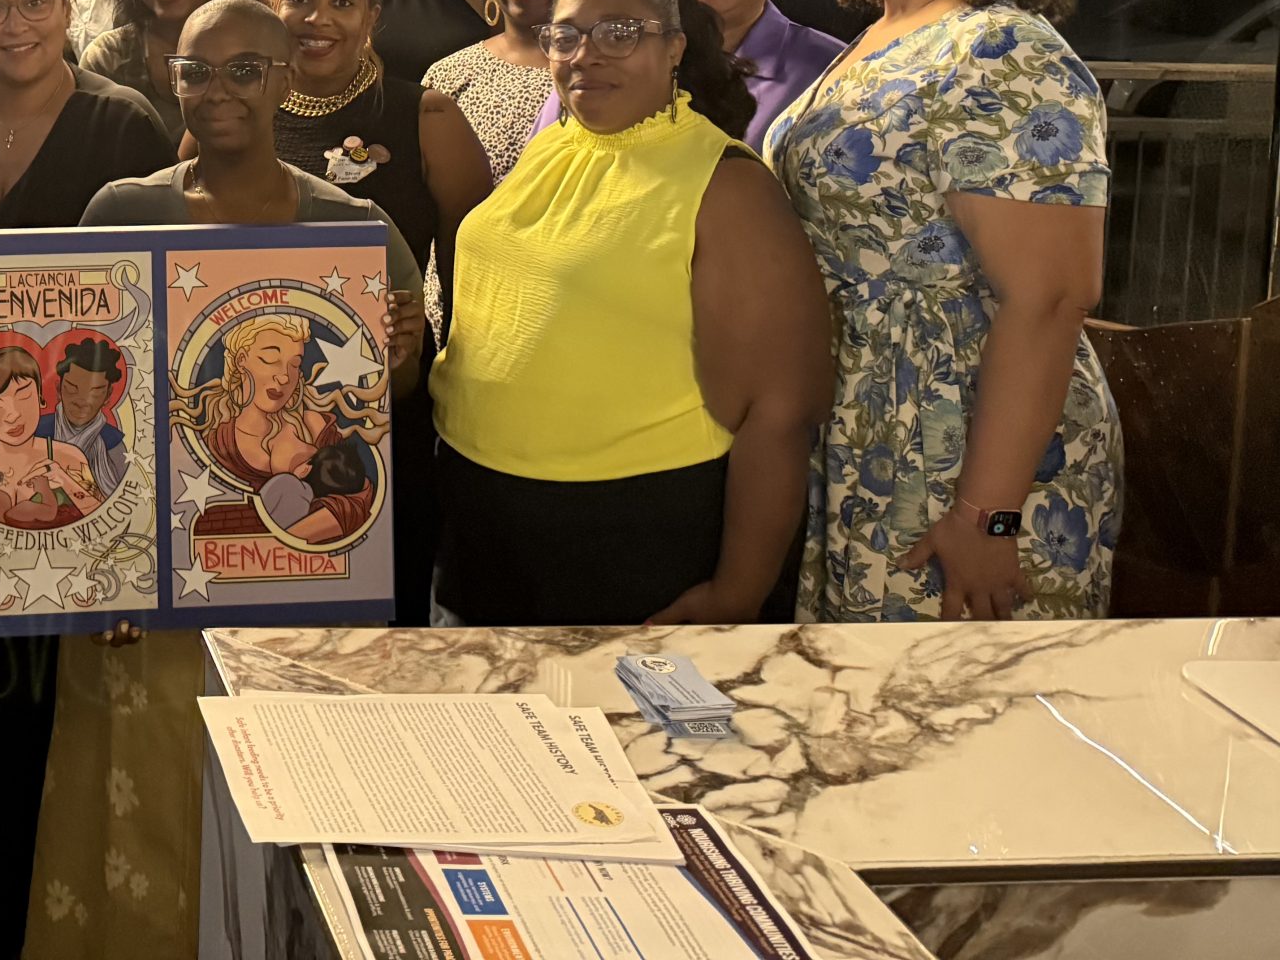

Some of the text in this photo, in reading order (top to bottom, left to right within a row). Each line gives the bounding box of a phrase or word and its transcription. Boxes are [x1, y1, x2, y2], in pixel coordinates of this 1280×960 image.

[6, 271, 76, 290] LACTANCIA
[209, 289, 290, 327] WELCOME
[71, 479, 140, 544] WELCOME
[204, 540, 338, 574] BIENVENIDA
[516, 701, 579, 776] SAFE TEAM HISTORY
[568, 714, 588, 732] SAFE
[578, 730, 600, 754] TEAM
[688, 828, 731, 869] NOURISHING
[720, 869, 758, 905] THRIVING
[745, 905, 800, 960] COMMUNITIES
